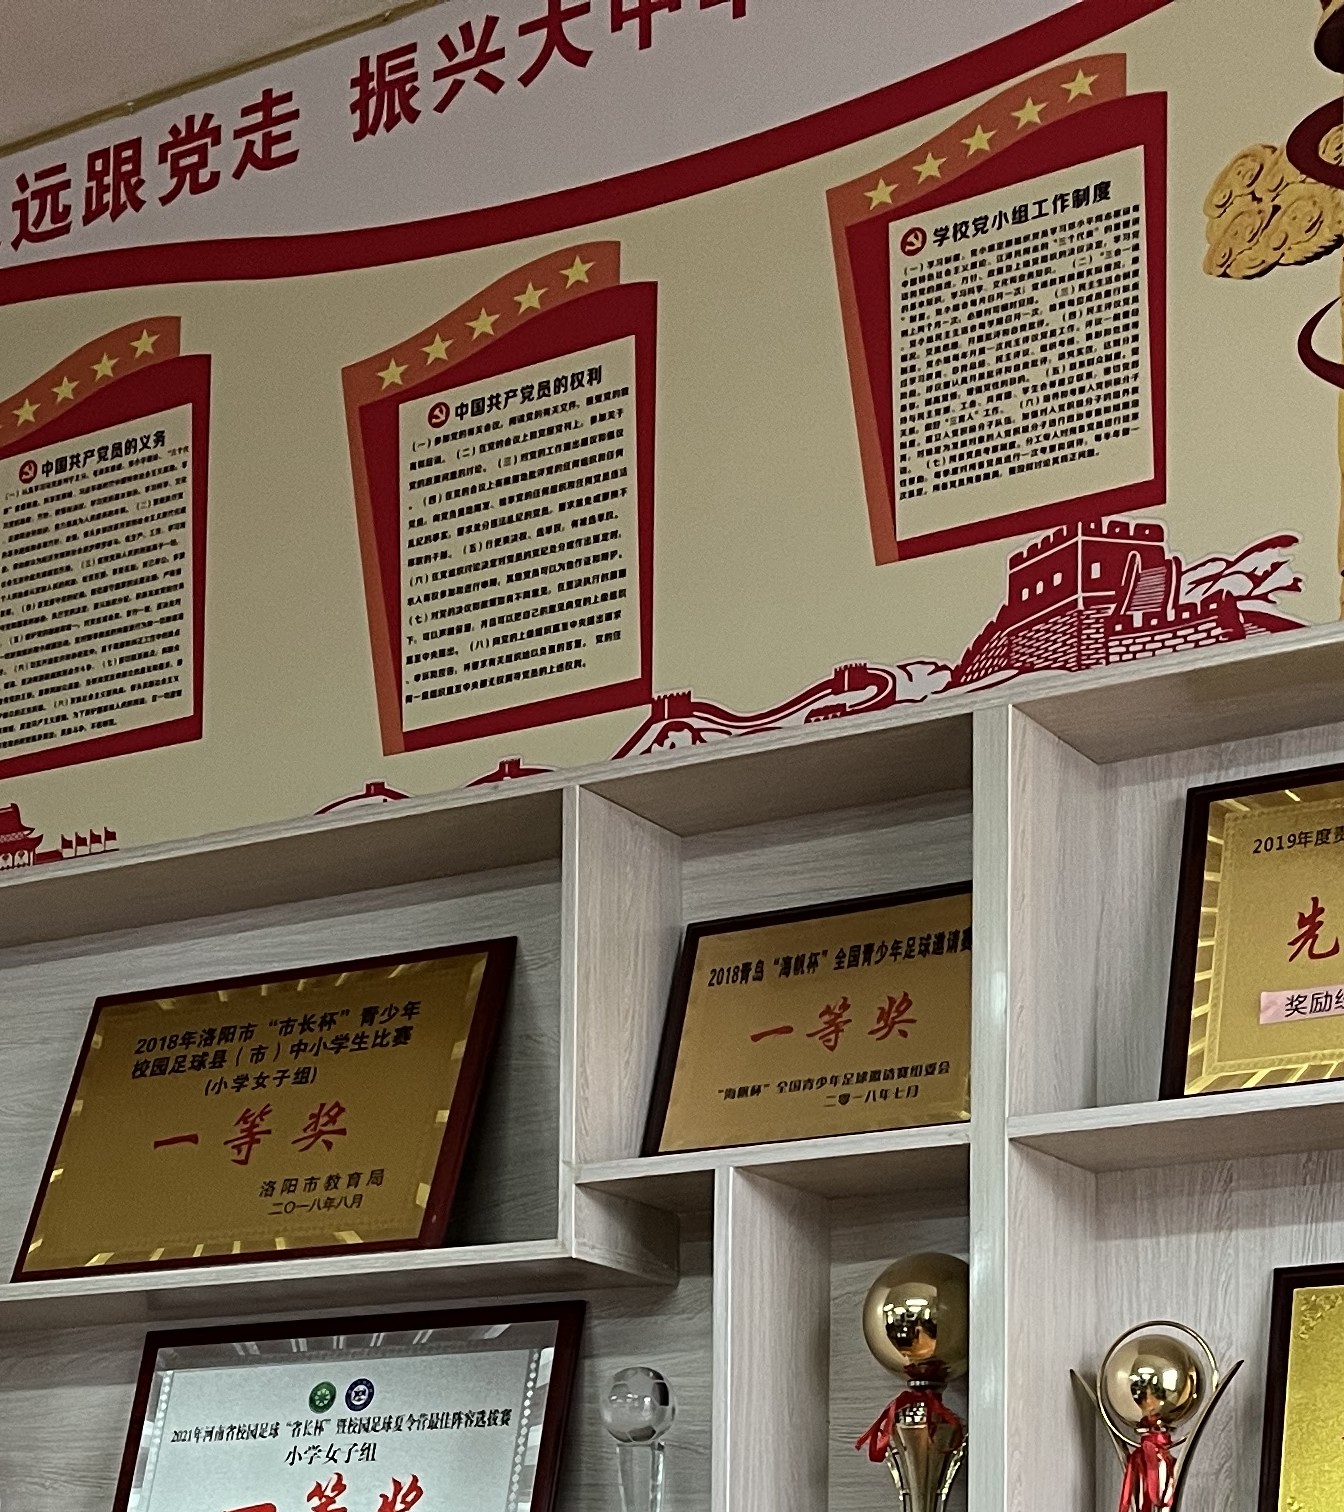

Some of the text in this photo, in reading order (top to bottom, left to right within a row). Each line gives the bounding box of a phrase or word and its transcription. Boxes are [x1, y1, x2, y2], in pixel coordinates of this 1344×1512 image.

[349, 0, 747, 142] 振兴大中
[933, 180, 1111, 247] 学校党小组工作制度
[455, 365, 602, 420] 中国共产党员的权利
[41, 429, 166, 477] 中国共产党员的义务
[750, 990, 917, 1052] 一等奖
[153, 1100, 348, 1166] 一等奖
[259, 1168, 385, 1198] 洛阳市教育局
[284, 1441, 377, 1466] 小学女子组
